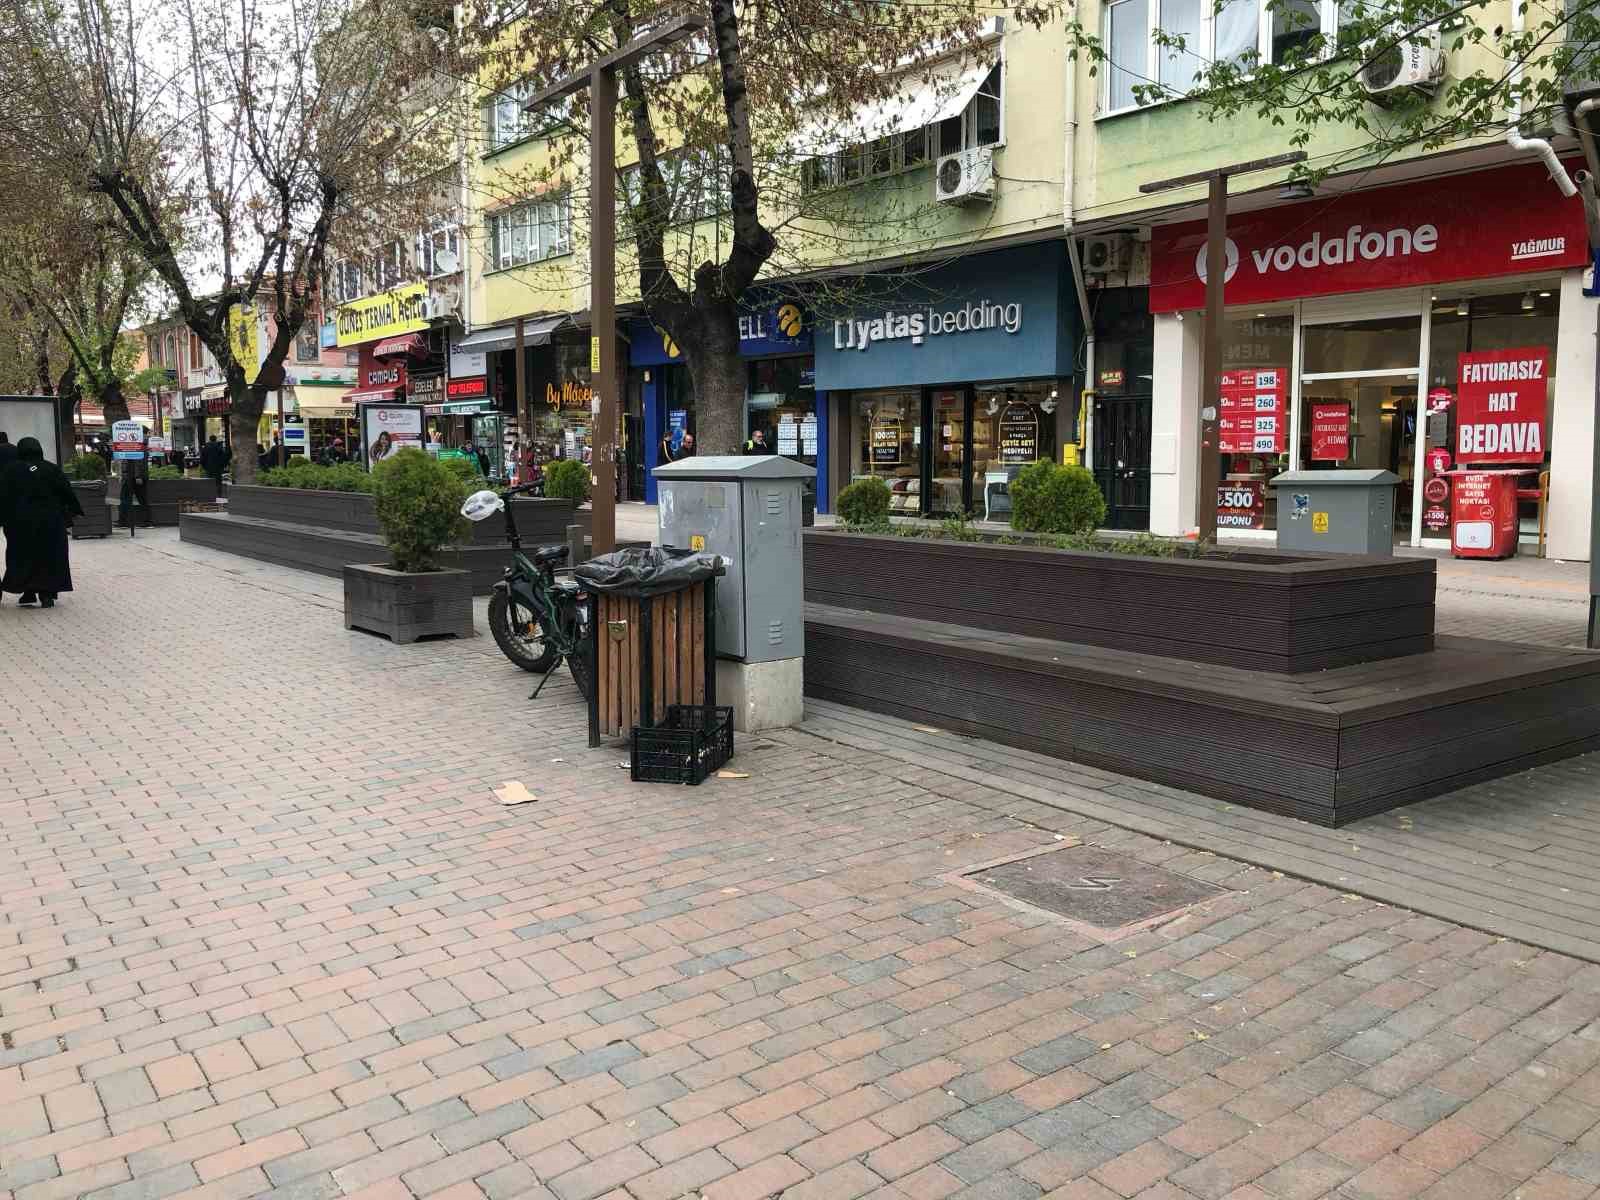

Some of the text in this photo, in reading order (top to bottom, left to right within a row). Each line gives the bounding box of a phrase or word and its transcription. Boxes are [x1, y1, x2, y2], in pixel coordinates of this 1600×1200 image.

[1251, 224, 1439, 274] vodafone
[1512, 237, 1566, 255] YAĞMUR
[364, 301, 396, 329] TERMAL
[929, 300, 1022, 334] bedding
[368, 368, 399, 385] CAMPUS
[1258, 376, 1275, 386] 198
[1462, 360, 1543, 384] FATURASIZ
[1257, 398, 1274, 408] 260
[1488, 391, 1518, 412] HAT
[1257, 421, 1273, 430] 325
[1256, 440, 1273, 449] 490
[1459, 422, 1541, 454] BEDAVA
